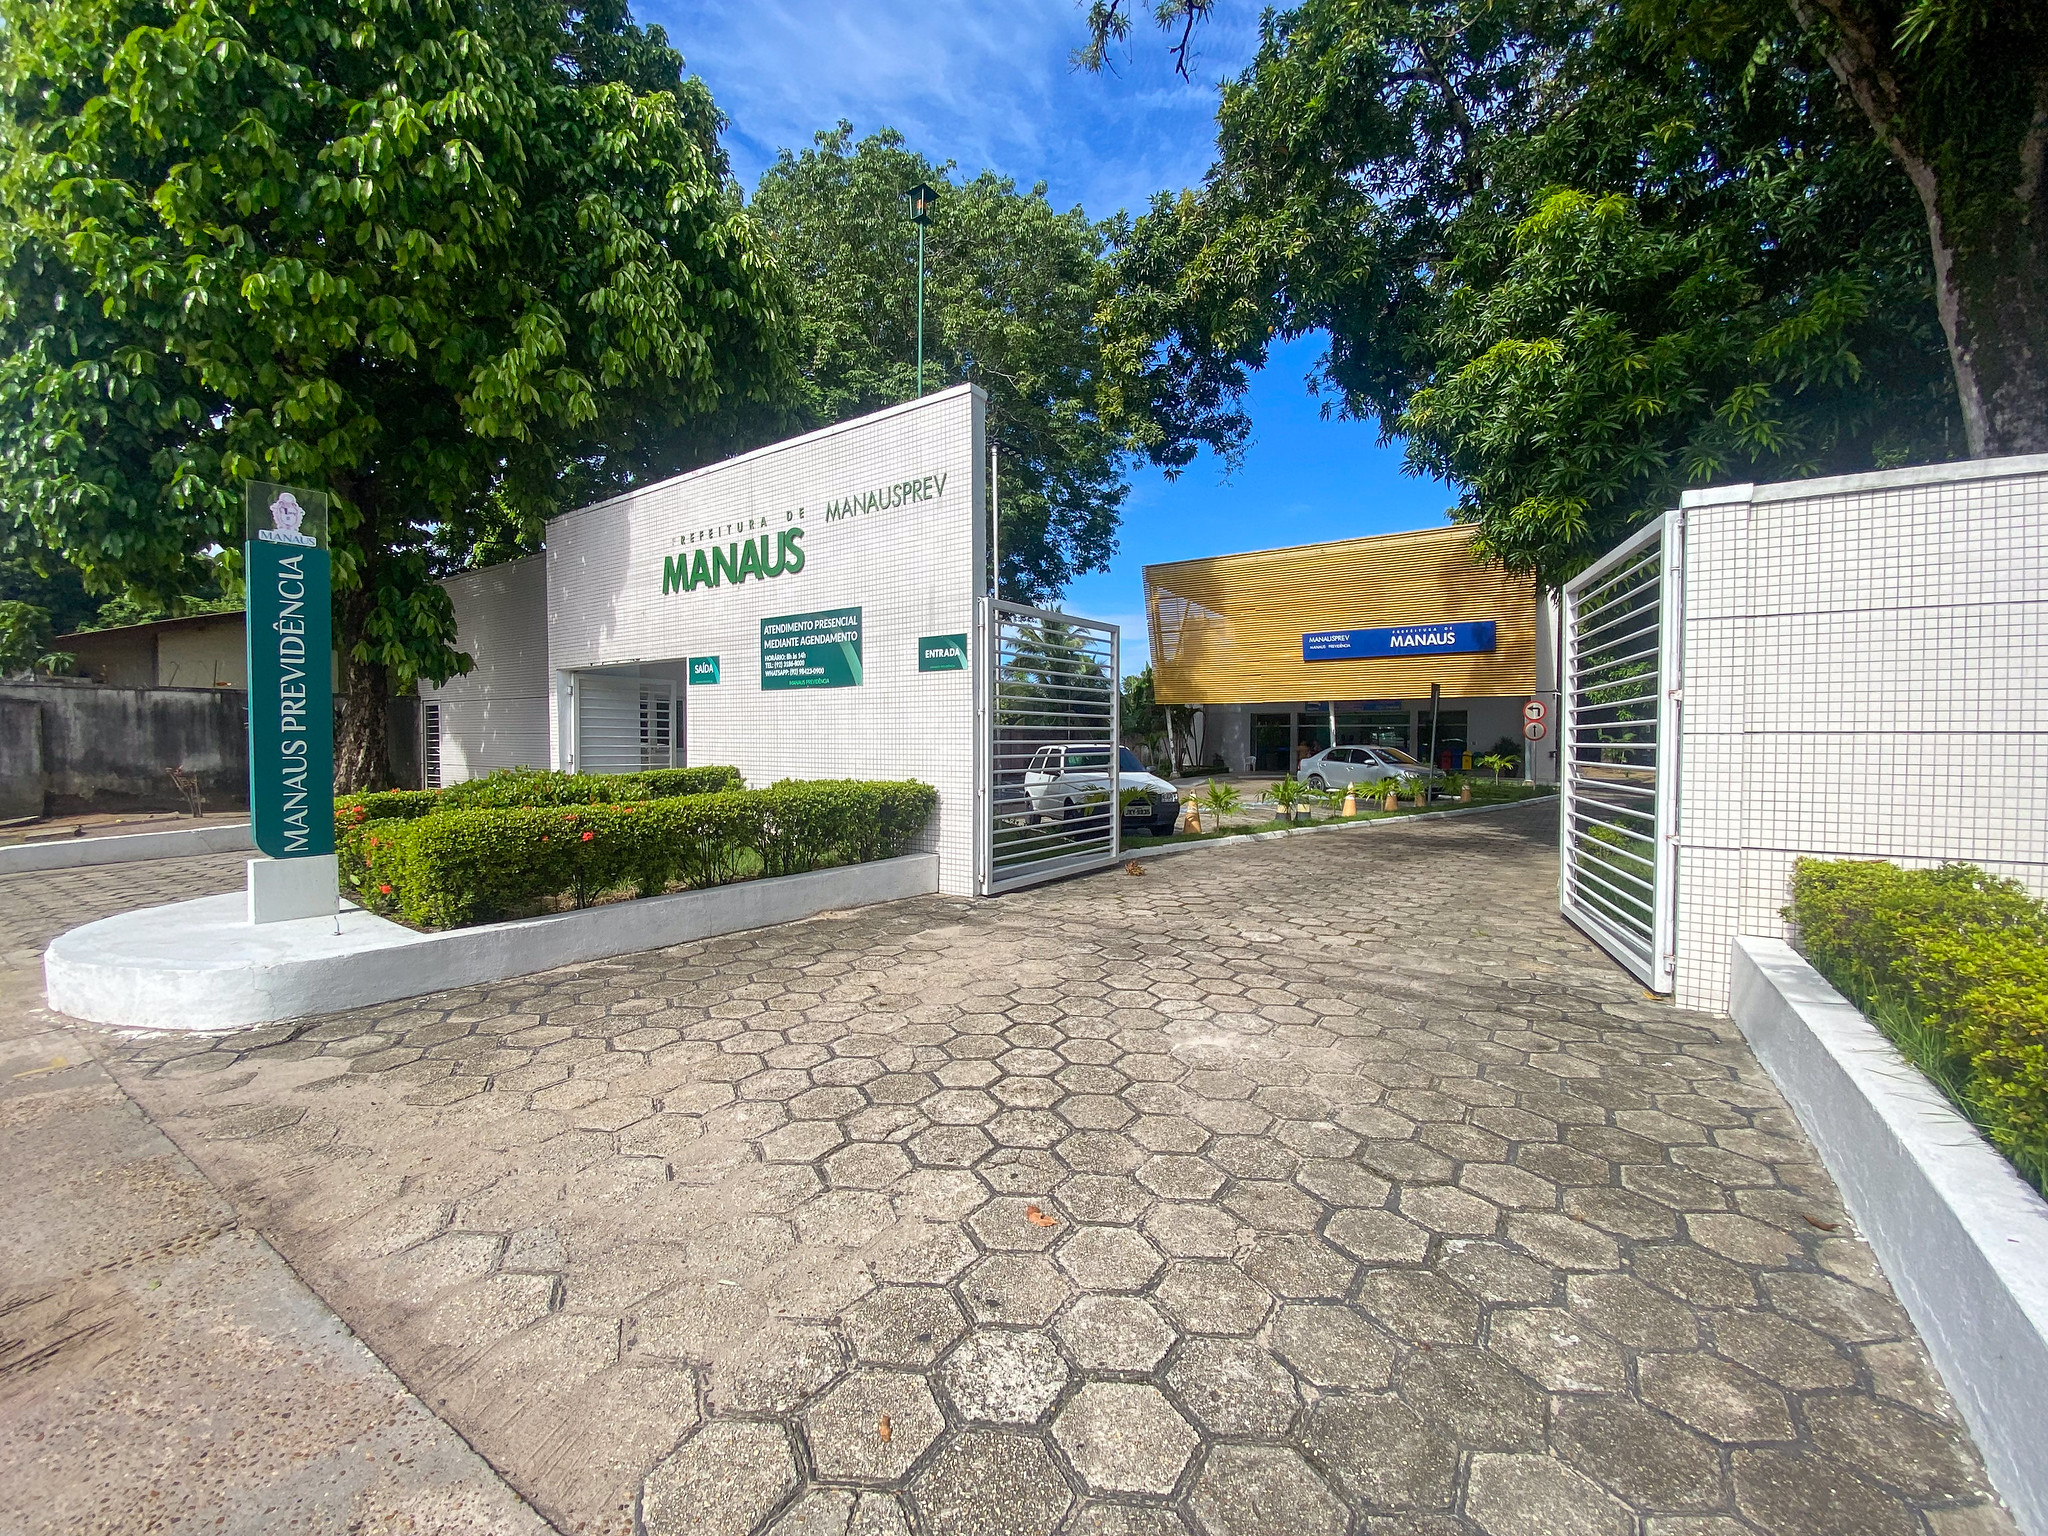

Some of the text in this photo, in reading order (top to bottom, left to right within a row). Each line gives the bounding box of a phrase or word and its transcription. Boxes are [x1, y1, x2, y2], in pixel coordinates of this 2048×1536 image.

[825, 473, 947, 523] MANAUSPREV
[786, 507, 805, 522] DE
[261, 531, 315, 546] MANAUS
[662, 527, 806, 595] MANAUS
[764, 616, 858, 635] ATENDIMENTO PRESENCIAL
[764, 631, 858, 649] MEDIANTE AGENDAMENTO
[1309, 635, 1350, 643] MANAUSPREV
[1390, 632, 1456, 648] MANAUS
[925, 648, 960, 659] ENTRADA
[694, 662, 713, 674] SAÍDA
[273, 554, 309, 852] MANAUS PREVIDÊNCIA
